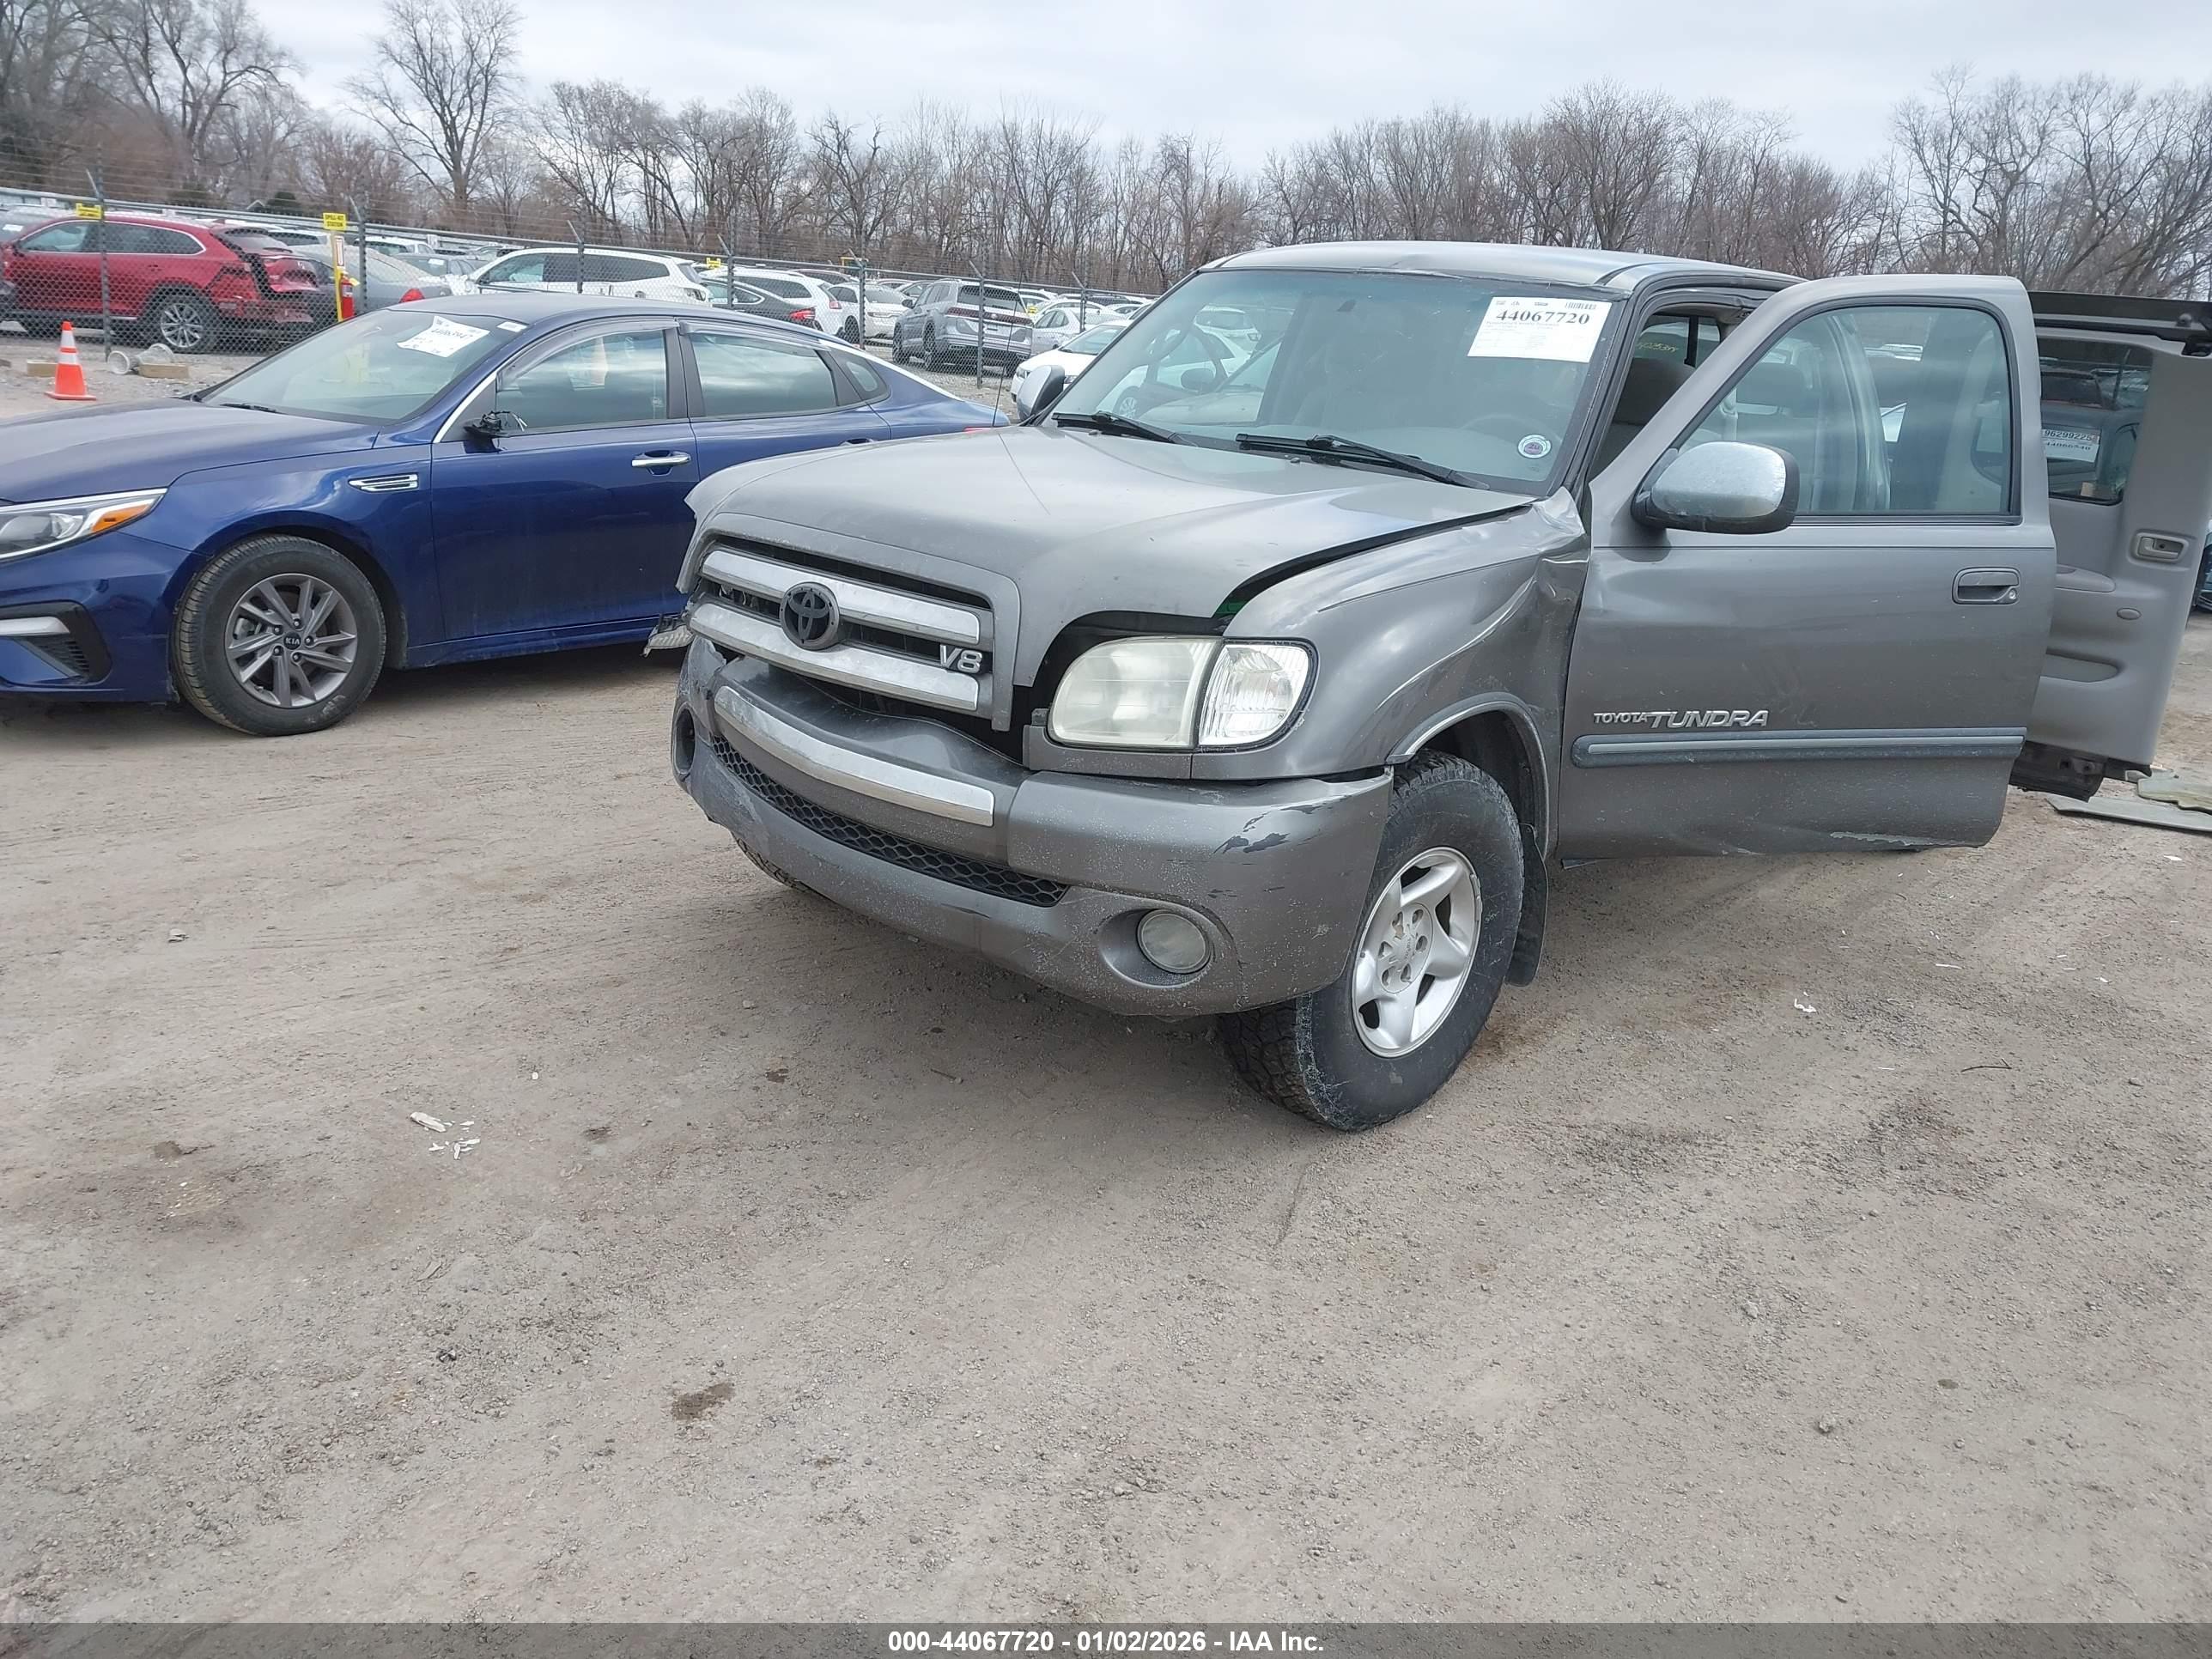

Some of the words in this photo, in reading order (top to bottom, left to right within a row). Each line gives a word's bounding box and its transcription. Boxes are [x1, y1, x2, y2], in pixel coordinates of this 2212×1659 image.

[1497, 310, 1590, 325] 44067720
[939, 644, 983, 674] V8
[1594, 712, 1649, 724] TOYOTA
[1648, 710, 1769, 729] TUNDRA
